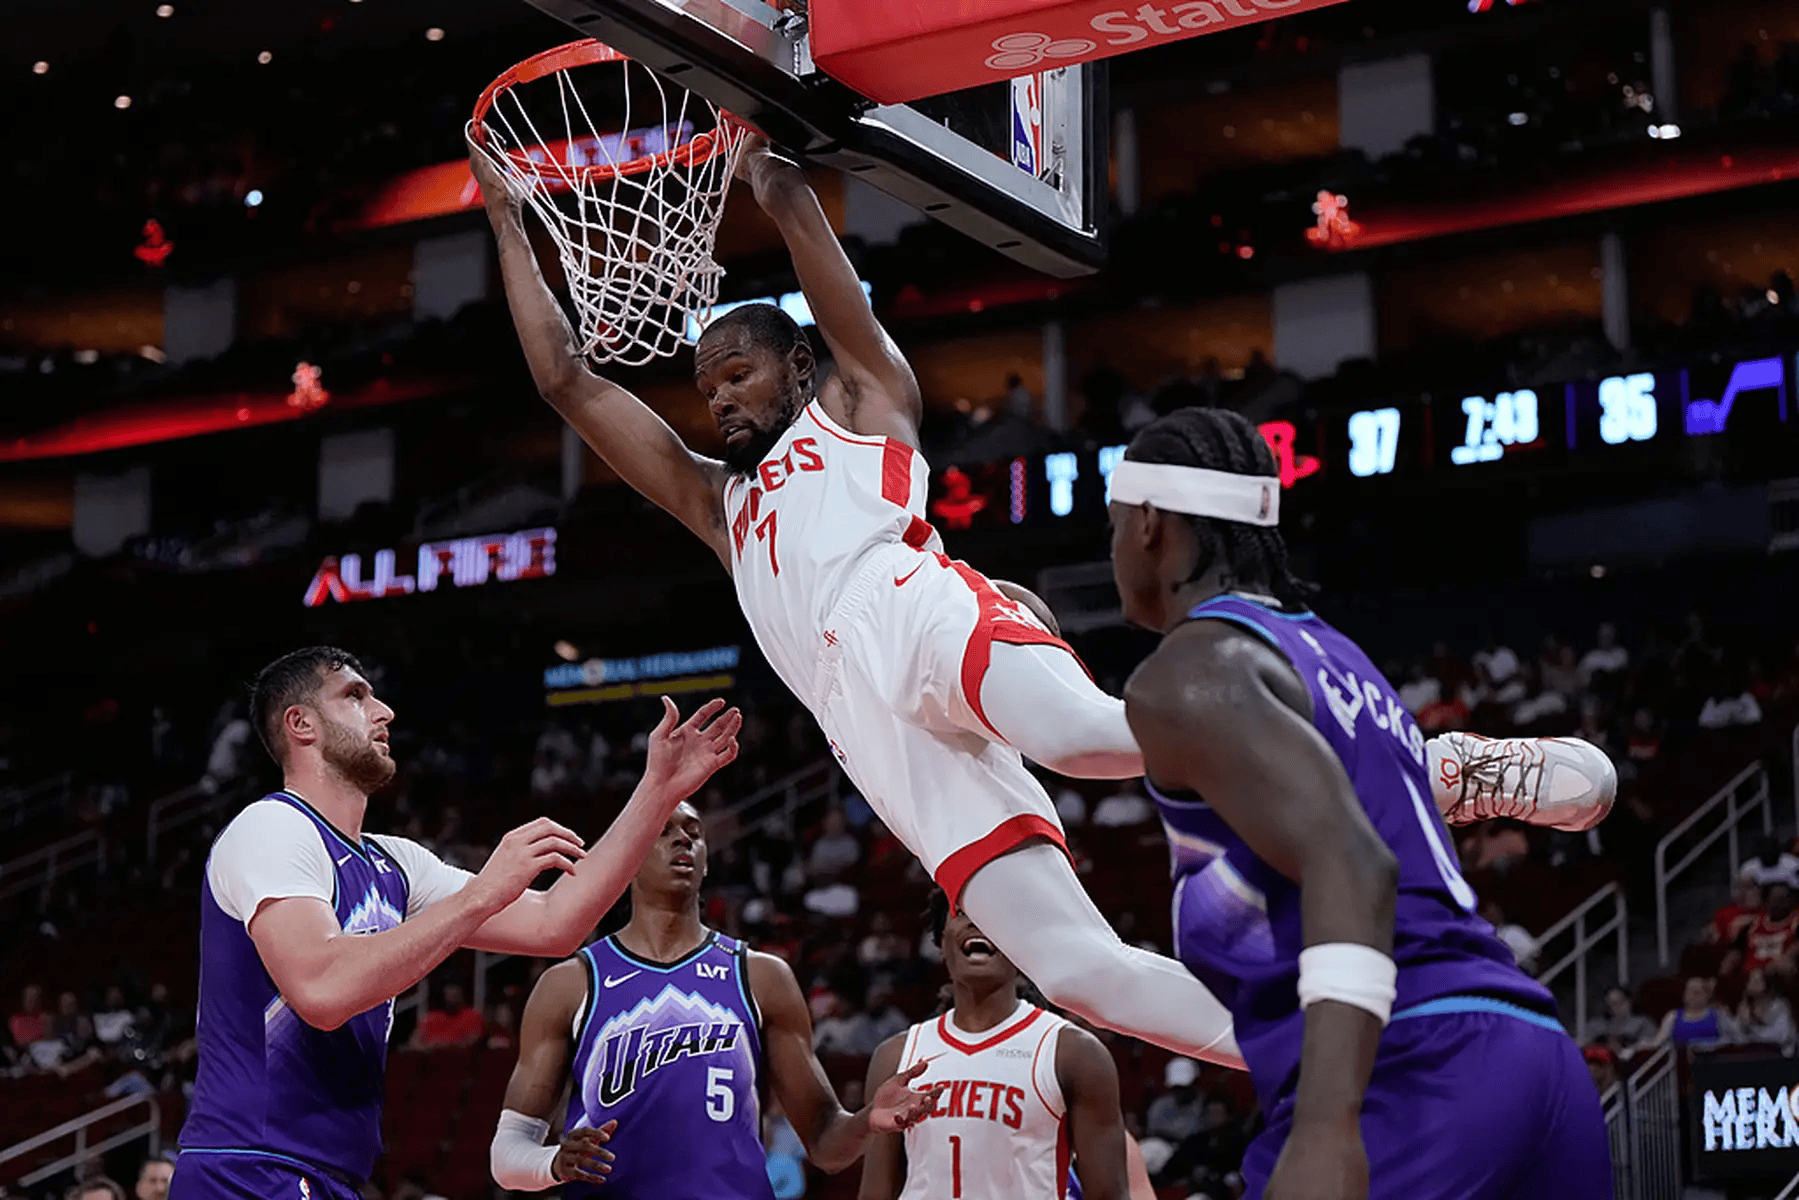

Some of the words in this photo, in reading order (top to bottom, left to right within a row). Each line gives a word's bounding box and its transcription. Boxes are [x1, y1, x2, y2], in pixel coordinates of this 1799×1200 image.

[754, 509, 780, 579] 7
[696, 963, 729, 980] LVT
[599, 1022, 744, 1107] UTAH
[706, 1066, 734, 1122] 5
[949, 1135, 962, 1199] 1
